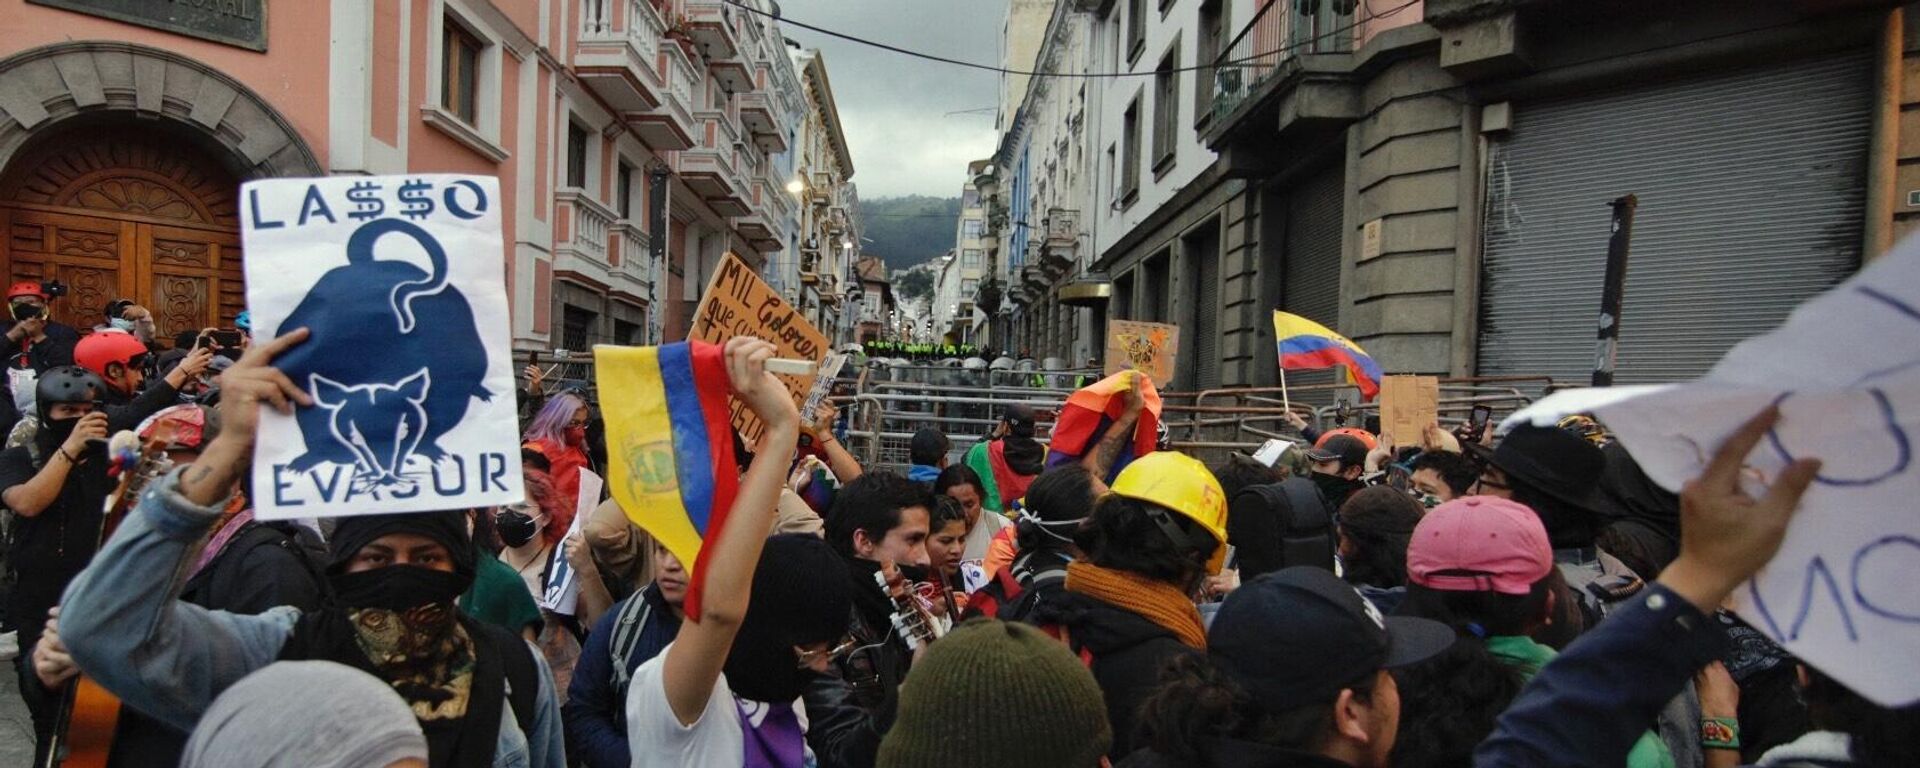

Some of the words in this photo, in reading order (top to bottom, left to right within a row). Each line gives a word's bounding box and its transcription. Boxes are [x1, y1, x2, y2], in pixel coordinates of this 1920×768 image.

[249, 179, 488, 230] LA$$O
[707, 296, 734, 329] que
[715, 257, 756, 309] MIL
[757, 294, 818, 361] Colores
